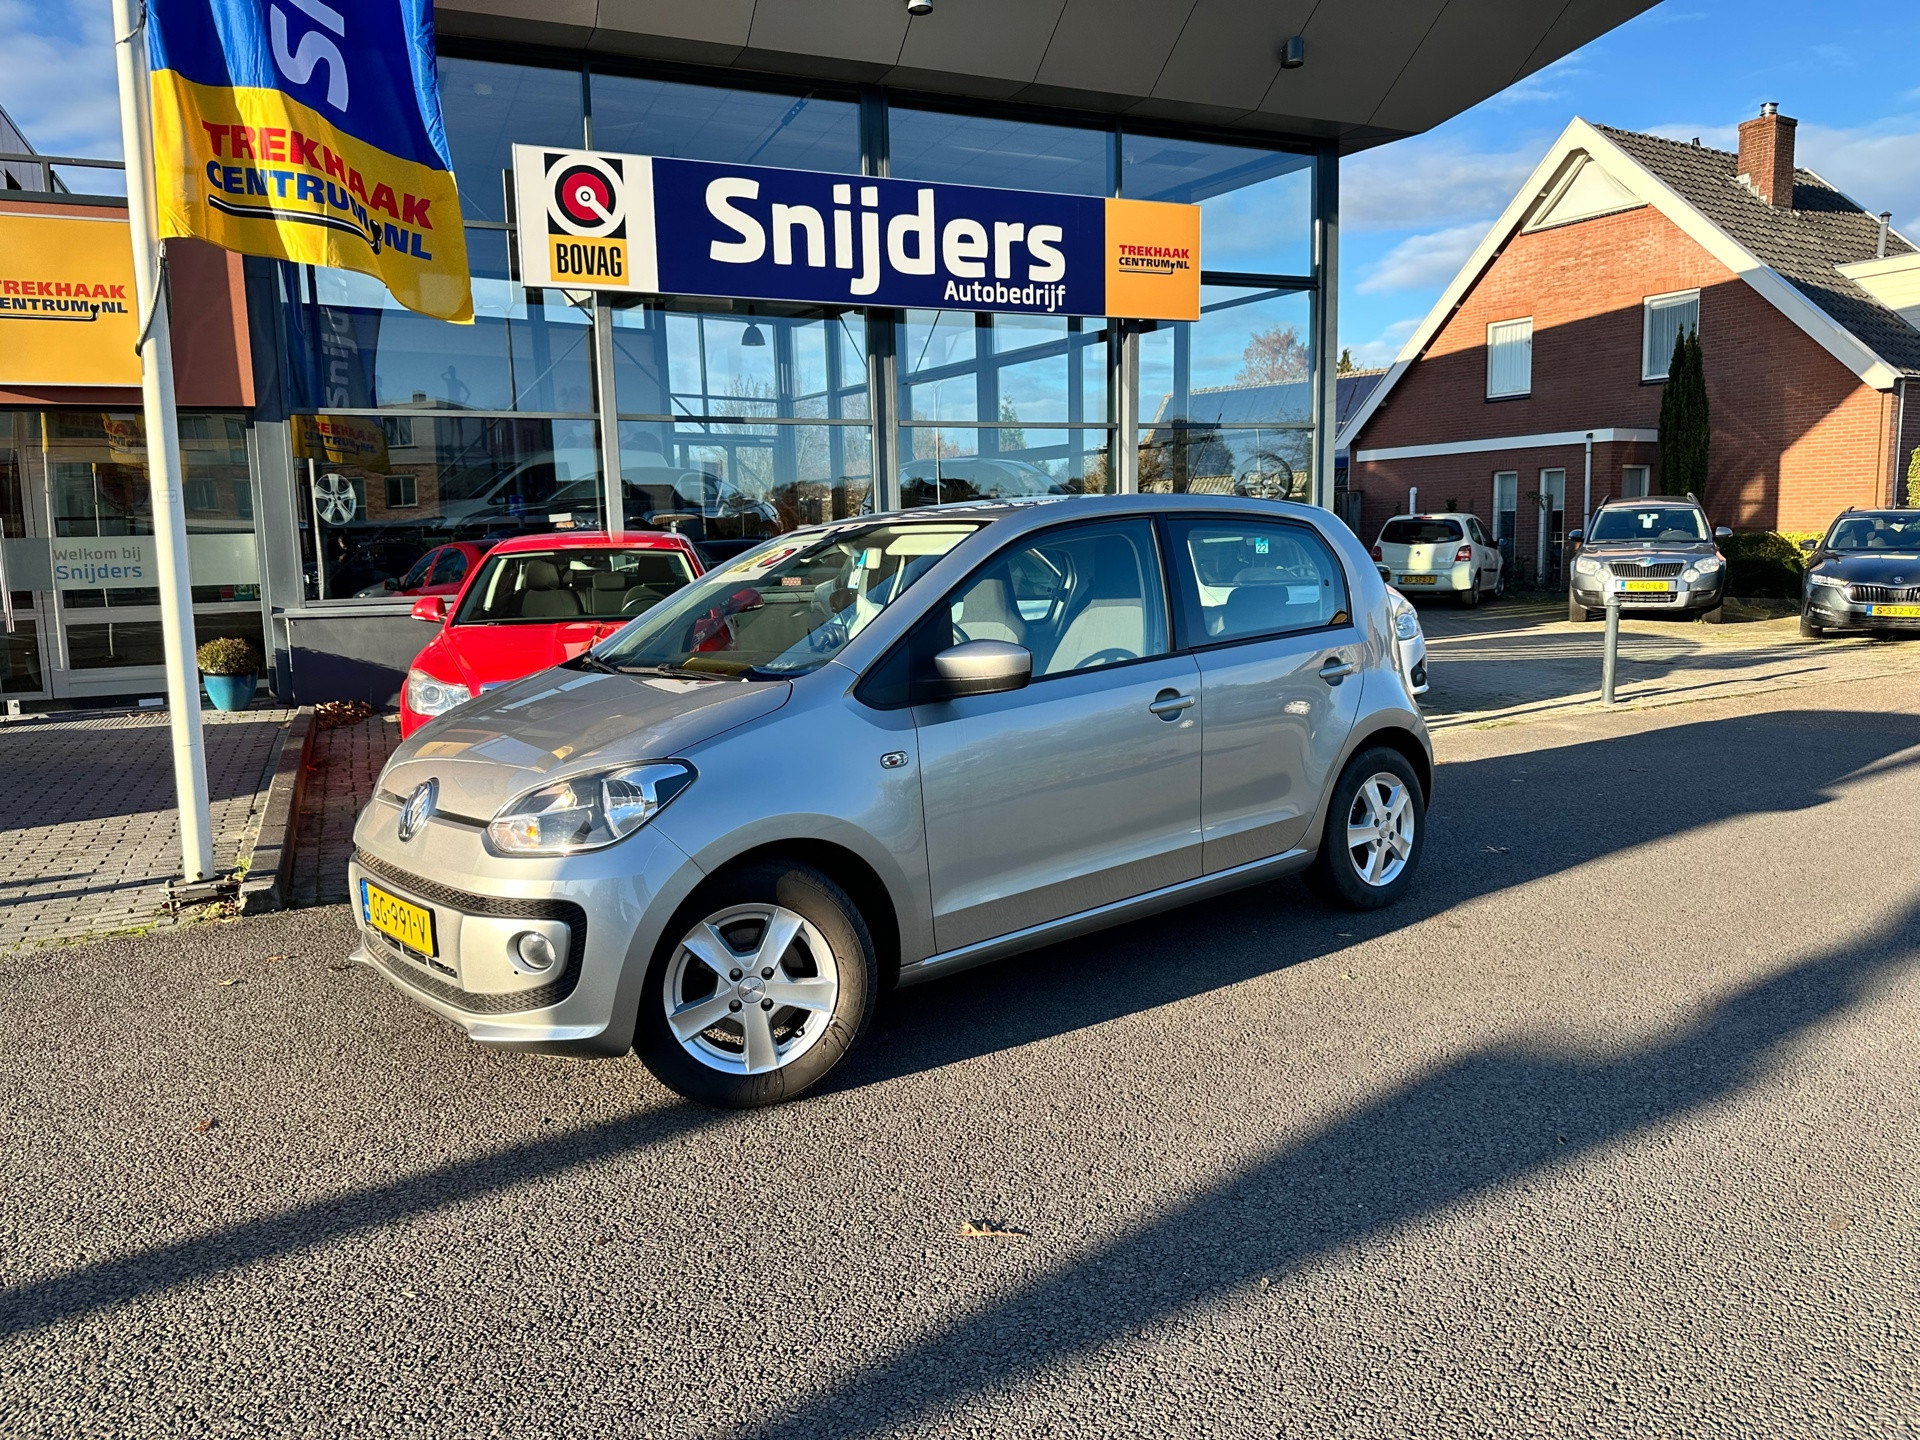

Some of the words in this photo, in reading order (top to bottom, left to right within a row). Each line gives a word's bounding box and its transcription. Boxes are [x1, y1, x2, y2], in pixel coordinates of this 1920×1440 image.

[202, 119, 433, 230] TREKHAAK
[705, 177, 1066, 296] Snijders
[1119, 244, 1190, 259] TREKHAAK
[556, 243, 623, 278] BOVAG
[0, 279, 127, 299] REKHAAK
[944, 280, 1066, 312] Autobedrijf
[53, 548, 117, 561] Welkom
[122, 546, 141, 562] bij
[55, 563, 143, 584] Snijders
[372, 892, 426, 945] GG-991-V
